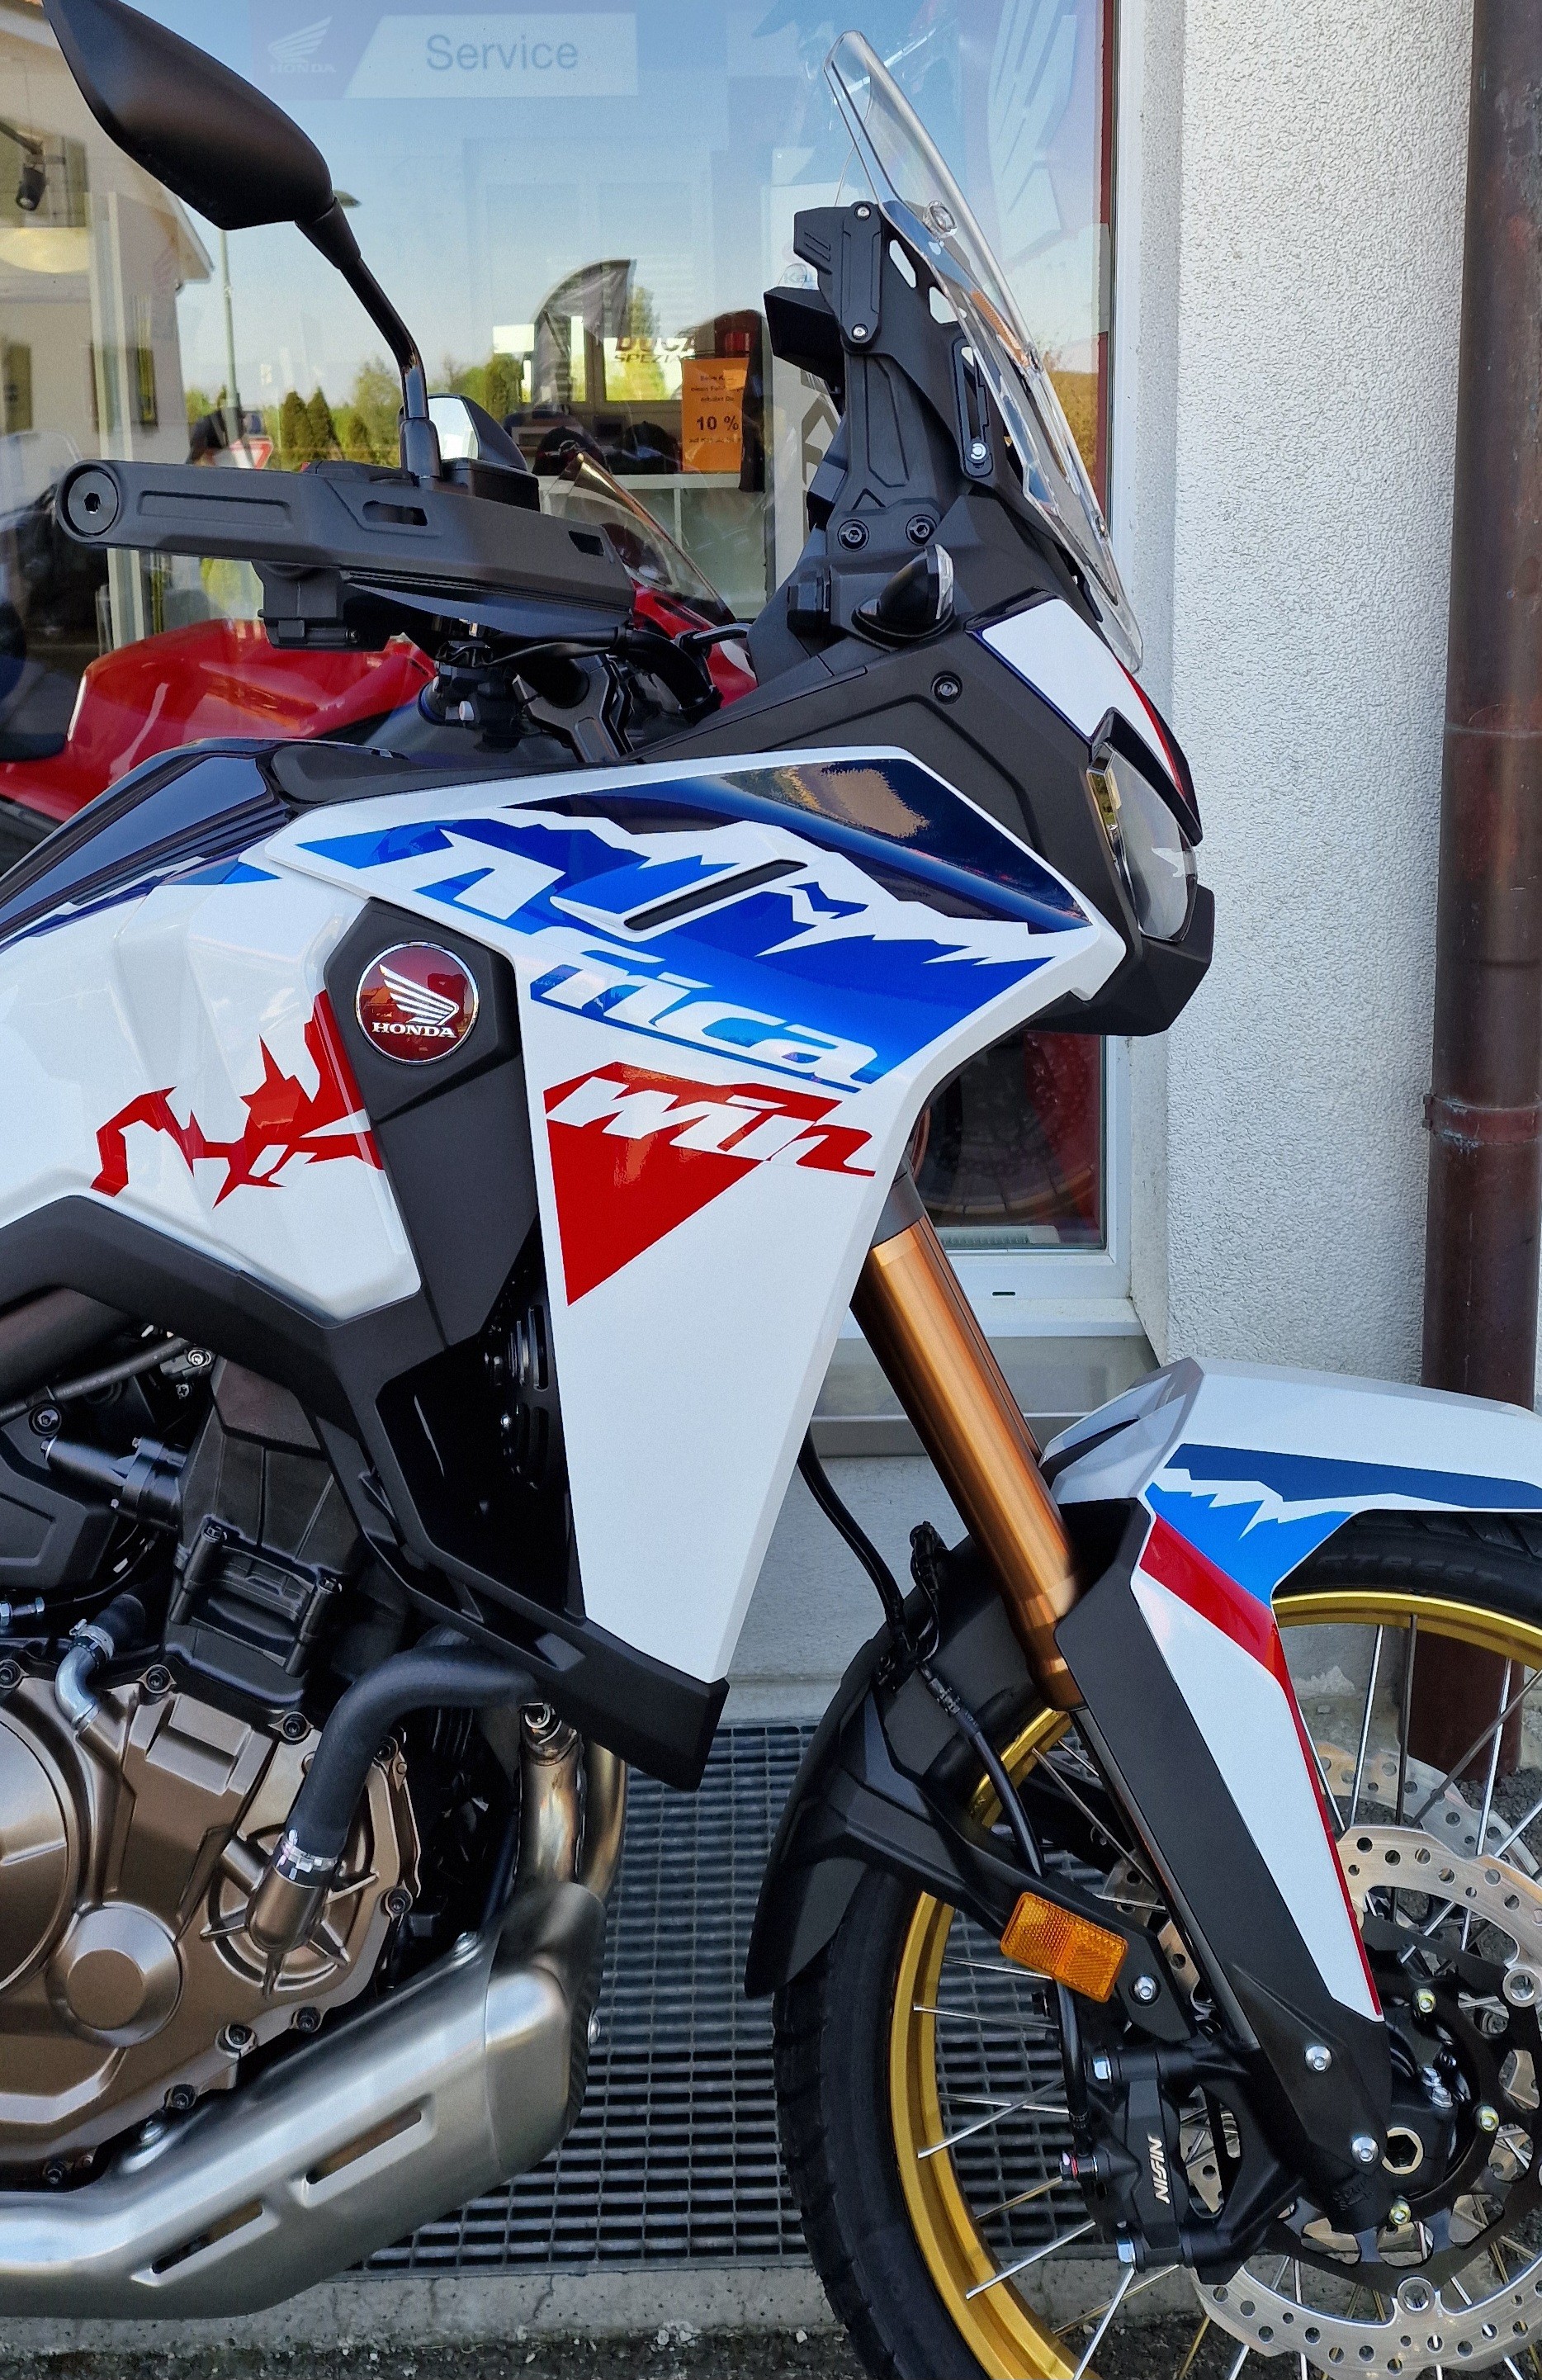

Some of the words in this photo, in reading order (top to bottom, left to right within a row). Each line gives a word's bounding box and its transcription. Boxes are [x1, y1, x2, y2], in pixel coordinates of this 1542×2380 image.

[426, 33, 578, 71] Service
[696, 415, 717, 431] 10
[723, 415, 740, 431] %
[371, 1021, 456, 1039] HONDA
